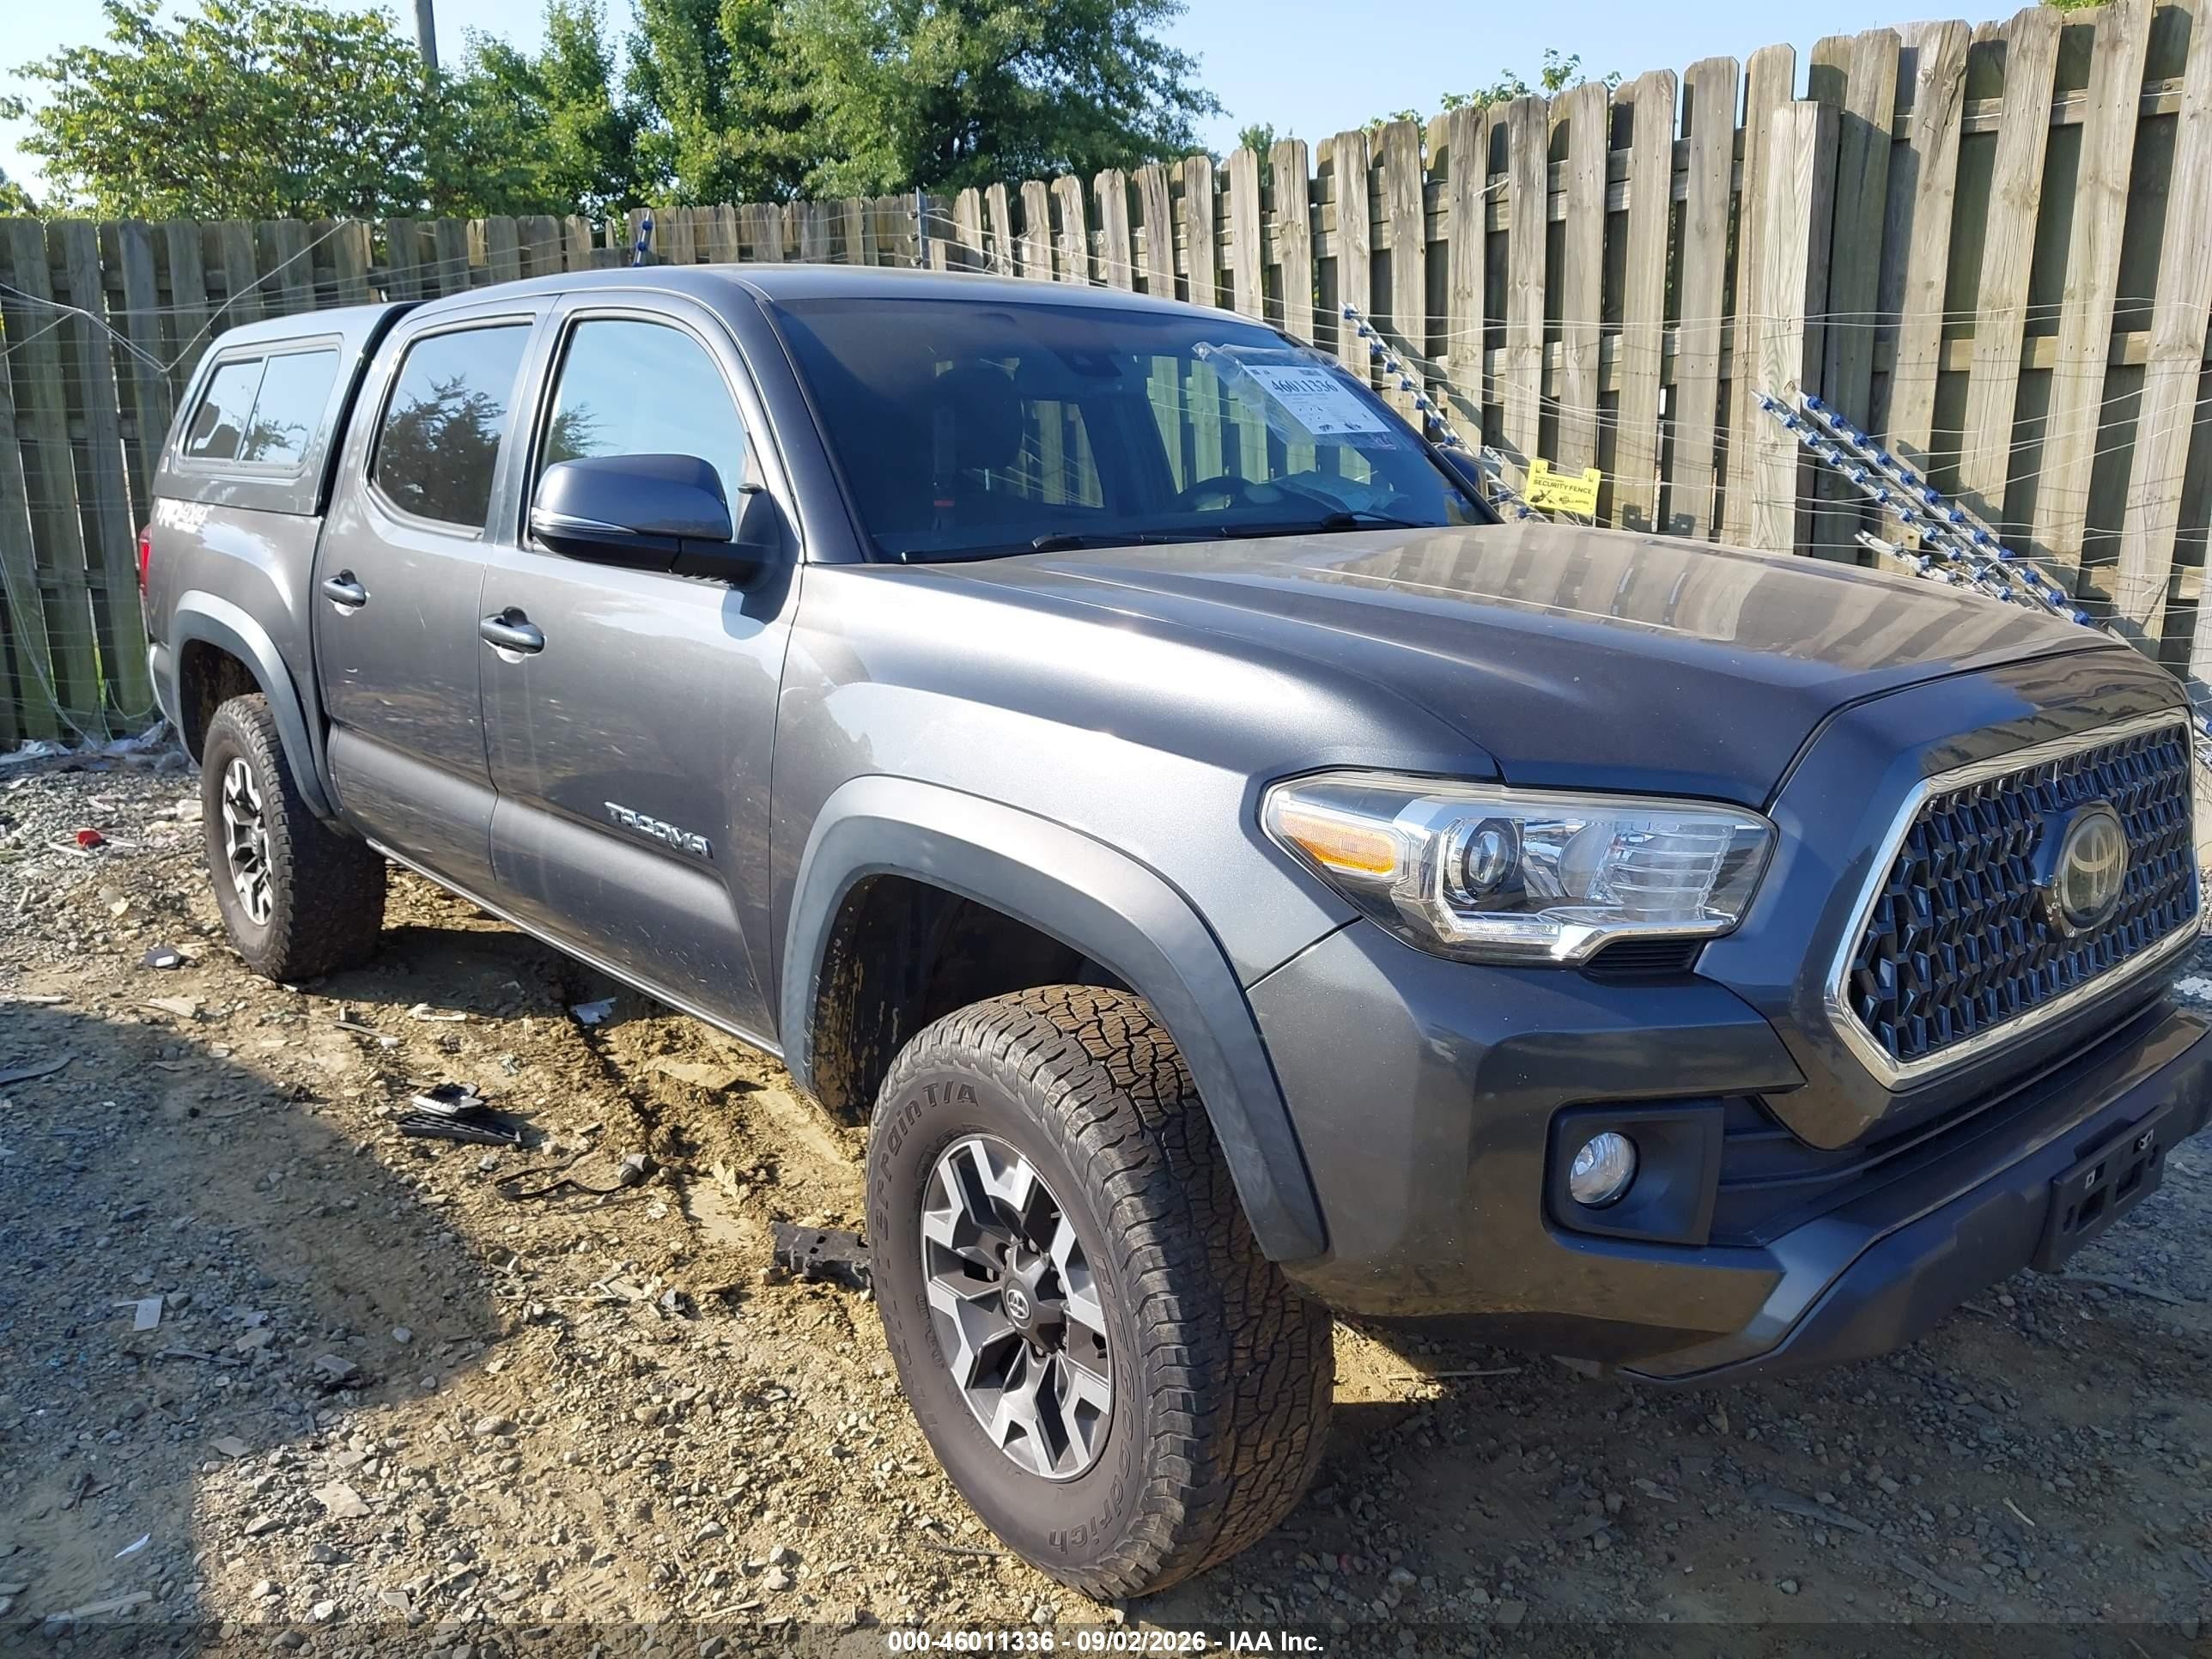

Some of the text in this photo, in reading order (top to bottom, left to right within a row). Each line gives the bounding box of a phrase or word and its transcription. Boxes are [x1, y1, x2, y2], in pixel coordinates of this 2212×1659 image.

[1271, 380, 1340, 393] 46011336
[1533, 478, 1568, 491] SECURITY
[1569, 485, 1593, 495] FENCE
[604, 801, 714, 859] TACOMA
[922, 1080, 979, 1108] T/A
